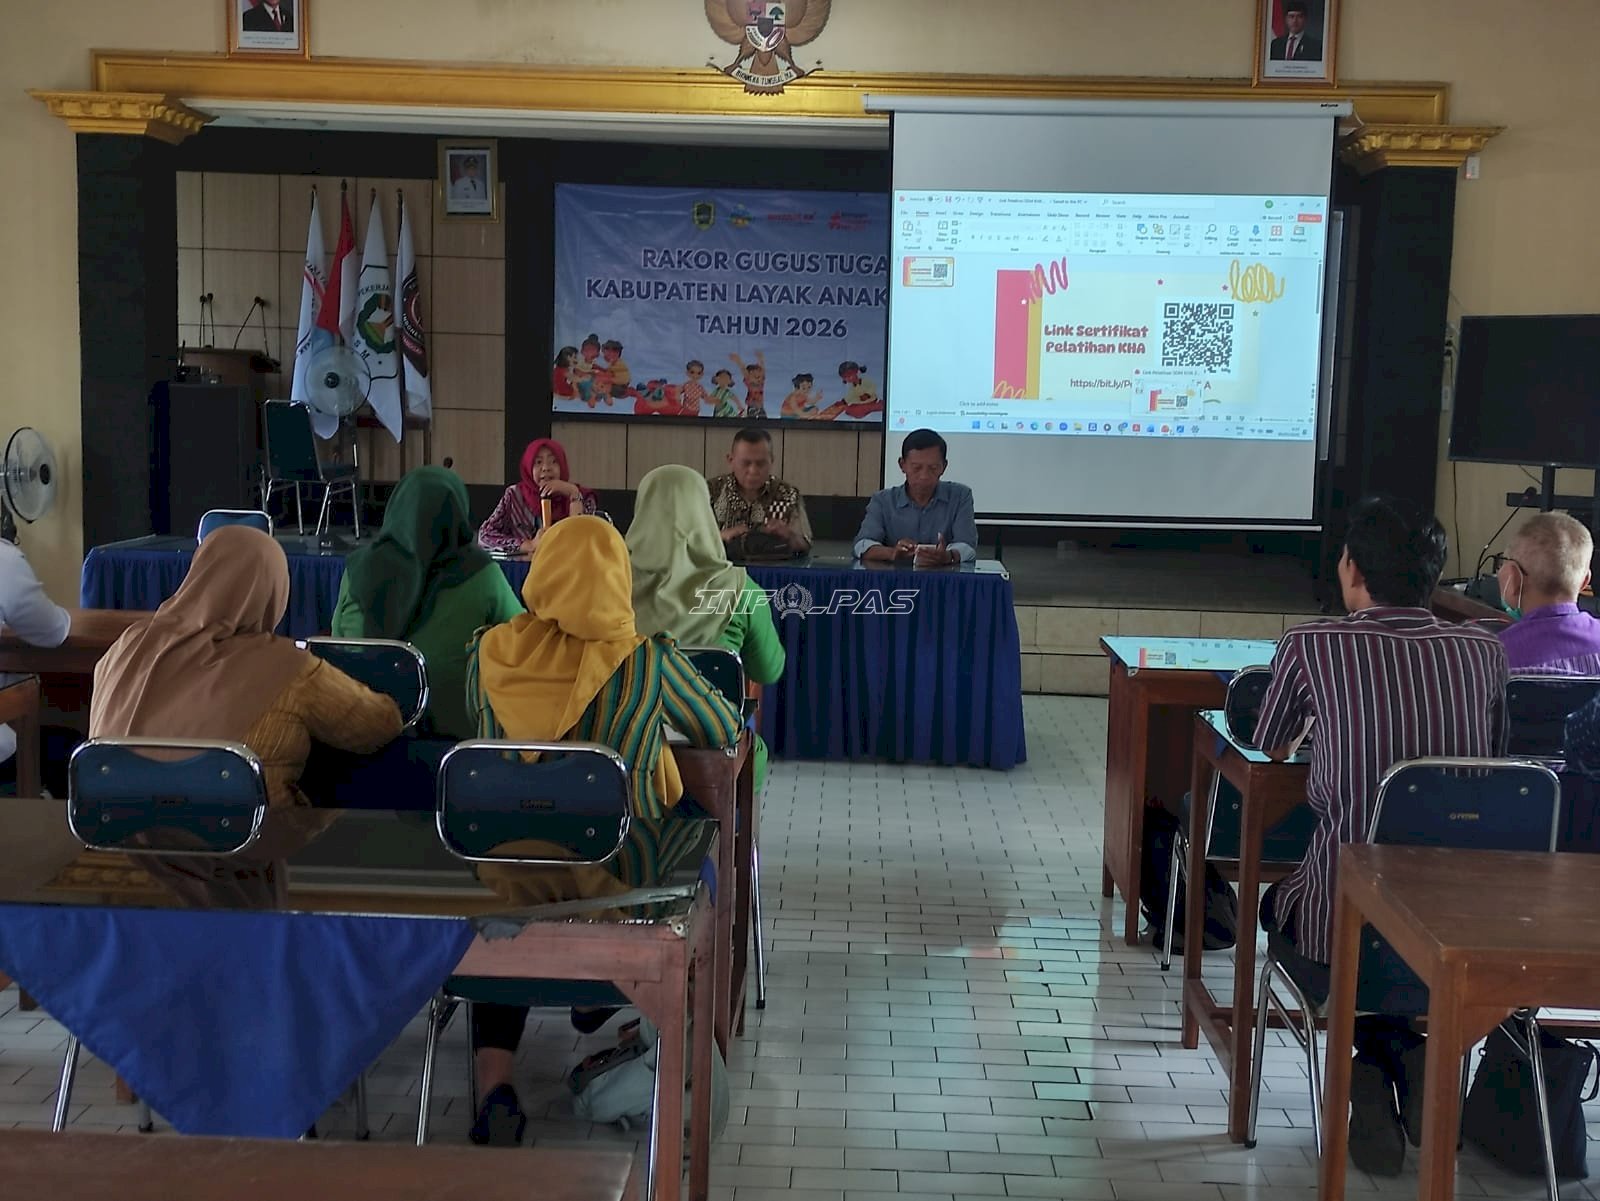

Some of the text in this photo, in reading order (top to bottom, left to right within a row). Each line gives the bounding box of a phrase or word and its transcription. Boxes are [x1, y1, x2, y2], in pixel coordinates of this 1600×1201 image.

[642, 249, 728, 270] RAKOR
[735, 252, 820, 273] GUGUS
[586, 279, 888, 307] KABUPATEN LAYAK ANAK
[696, 314, 848, 338] TAHUN 2026
[1044, 324, 1149, 337] Link Sertifikat
[1045, 341, 1146, 354] Pelatihan KHA
